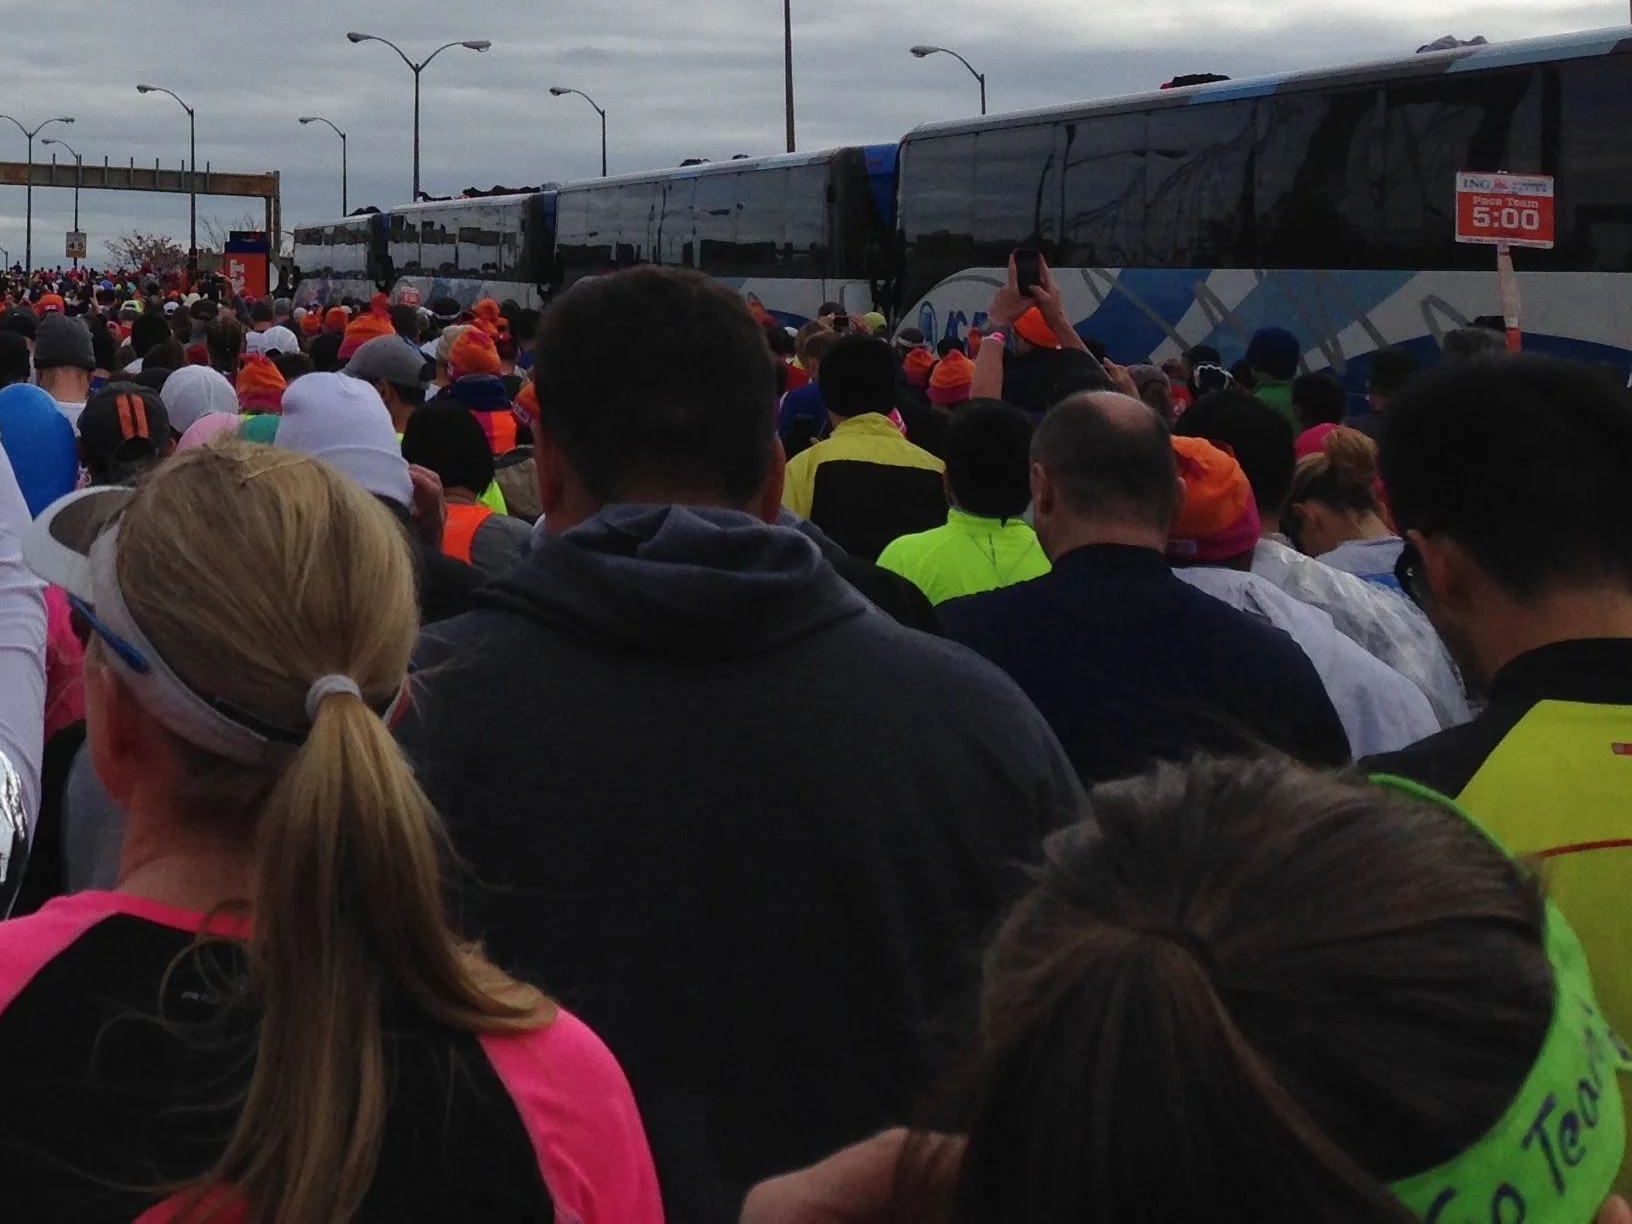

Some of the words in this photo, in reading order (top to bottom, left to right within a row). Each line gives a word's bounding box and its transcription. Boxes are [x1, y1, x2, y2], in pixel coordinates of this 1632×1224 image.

[1463, 179, 1489, 190] ING
[1472, 195, 1503, 206] Pace
[1506, 197, 1539, 209] Team
[1472, 206, 1540, 230] 5:00
